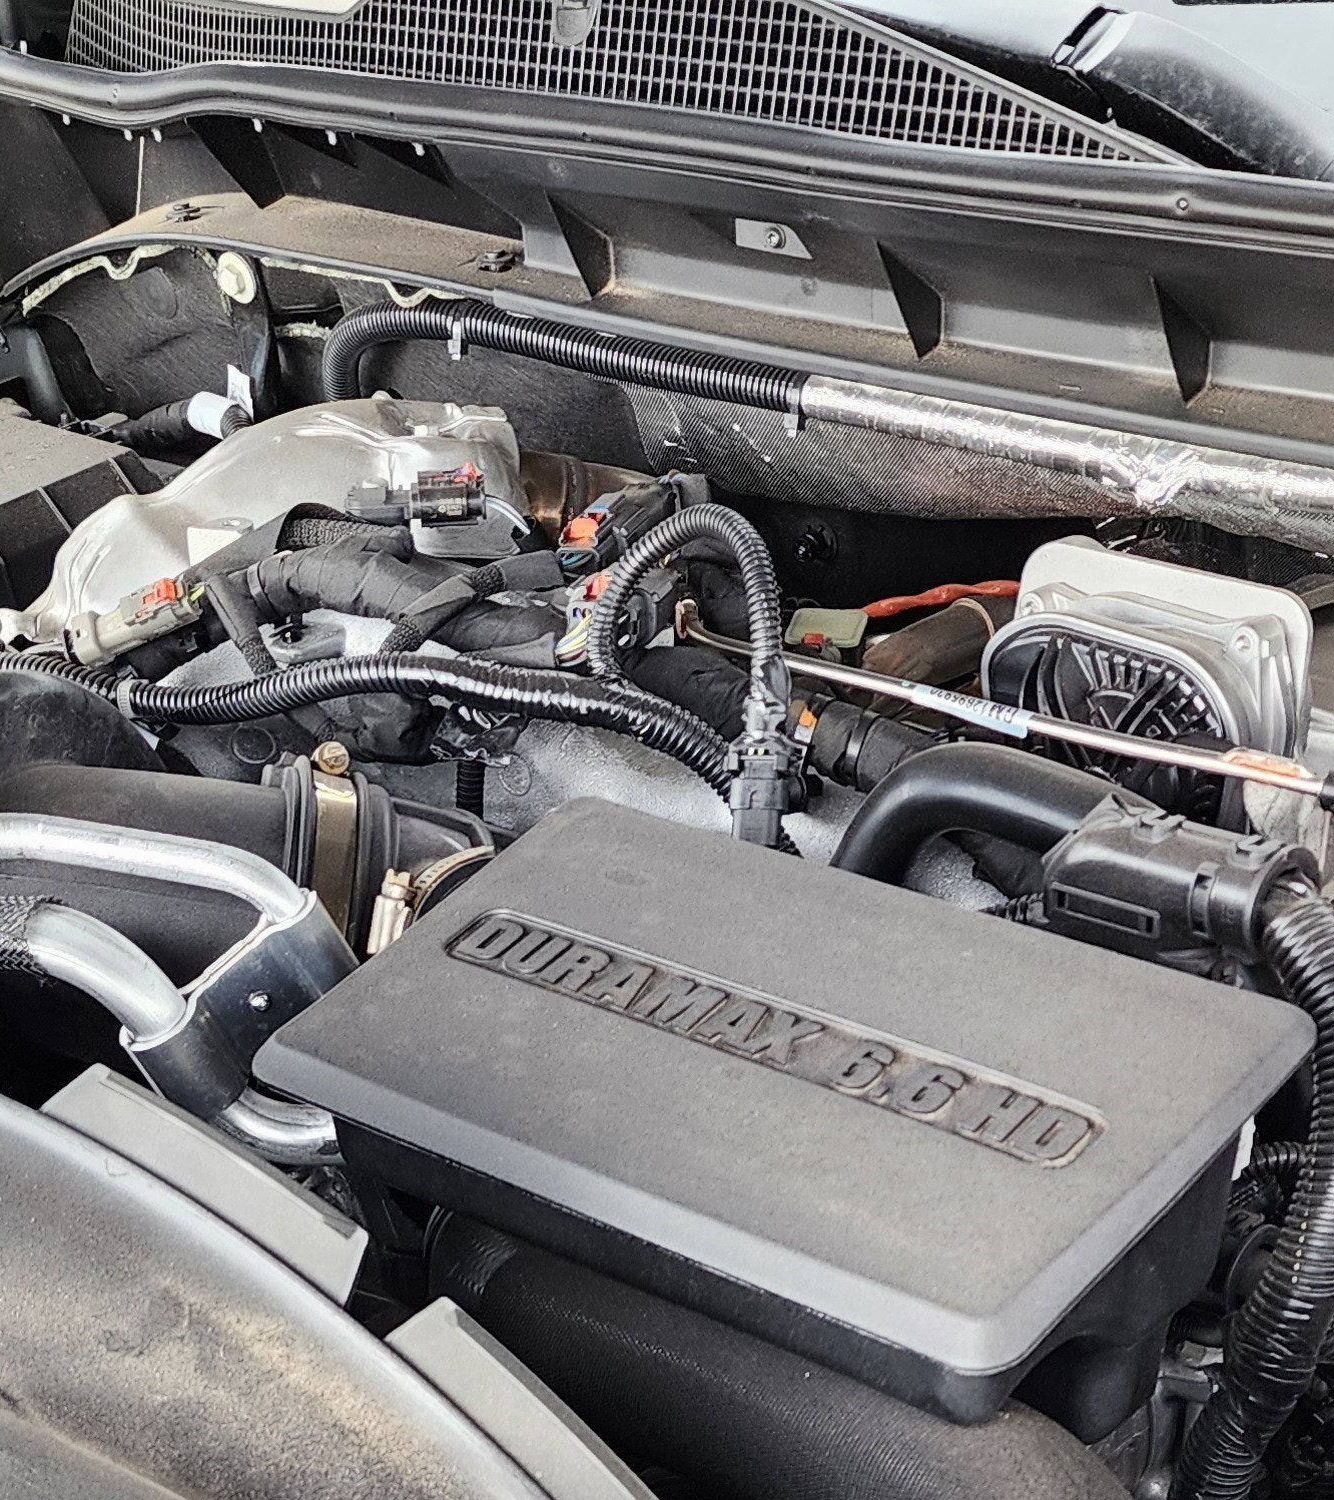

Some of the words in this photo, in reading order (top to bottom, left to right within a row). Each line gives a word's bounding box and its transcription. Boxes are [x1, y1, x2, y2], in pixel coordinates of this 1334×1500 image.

[454, 915, 827, 1067] DURAMAX
[830, 1039, 968, 1116] 6.6
[958, 1076, 1097, 1161] HD
